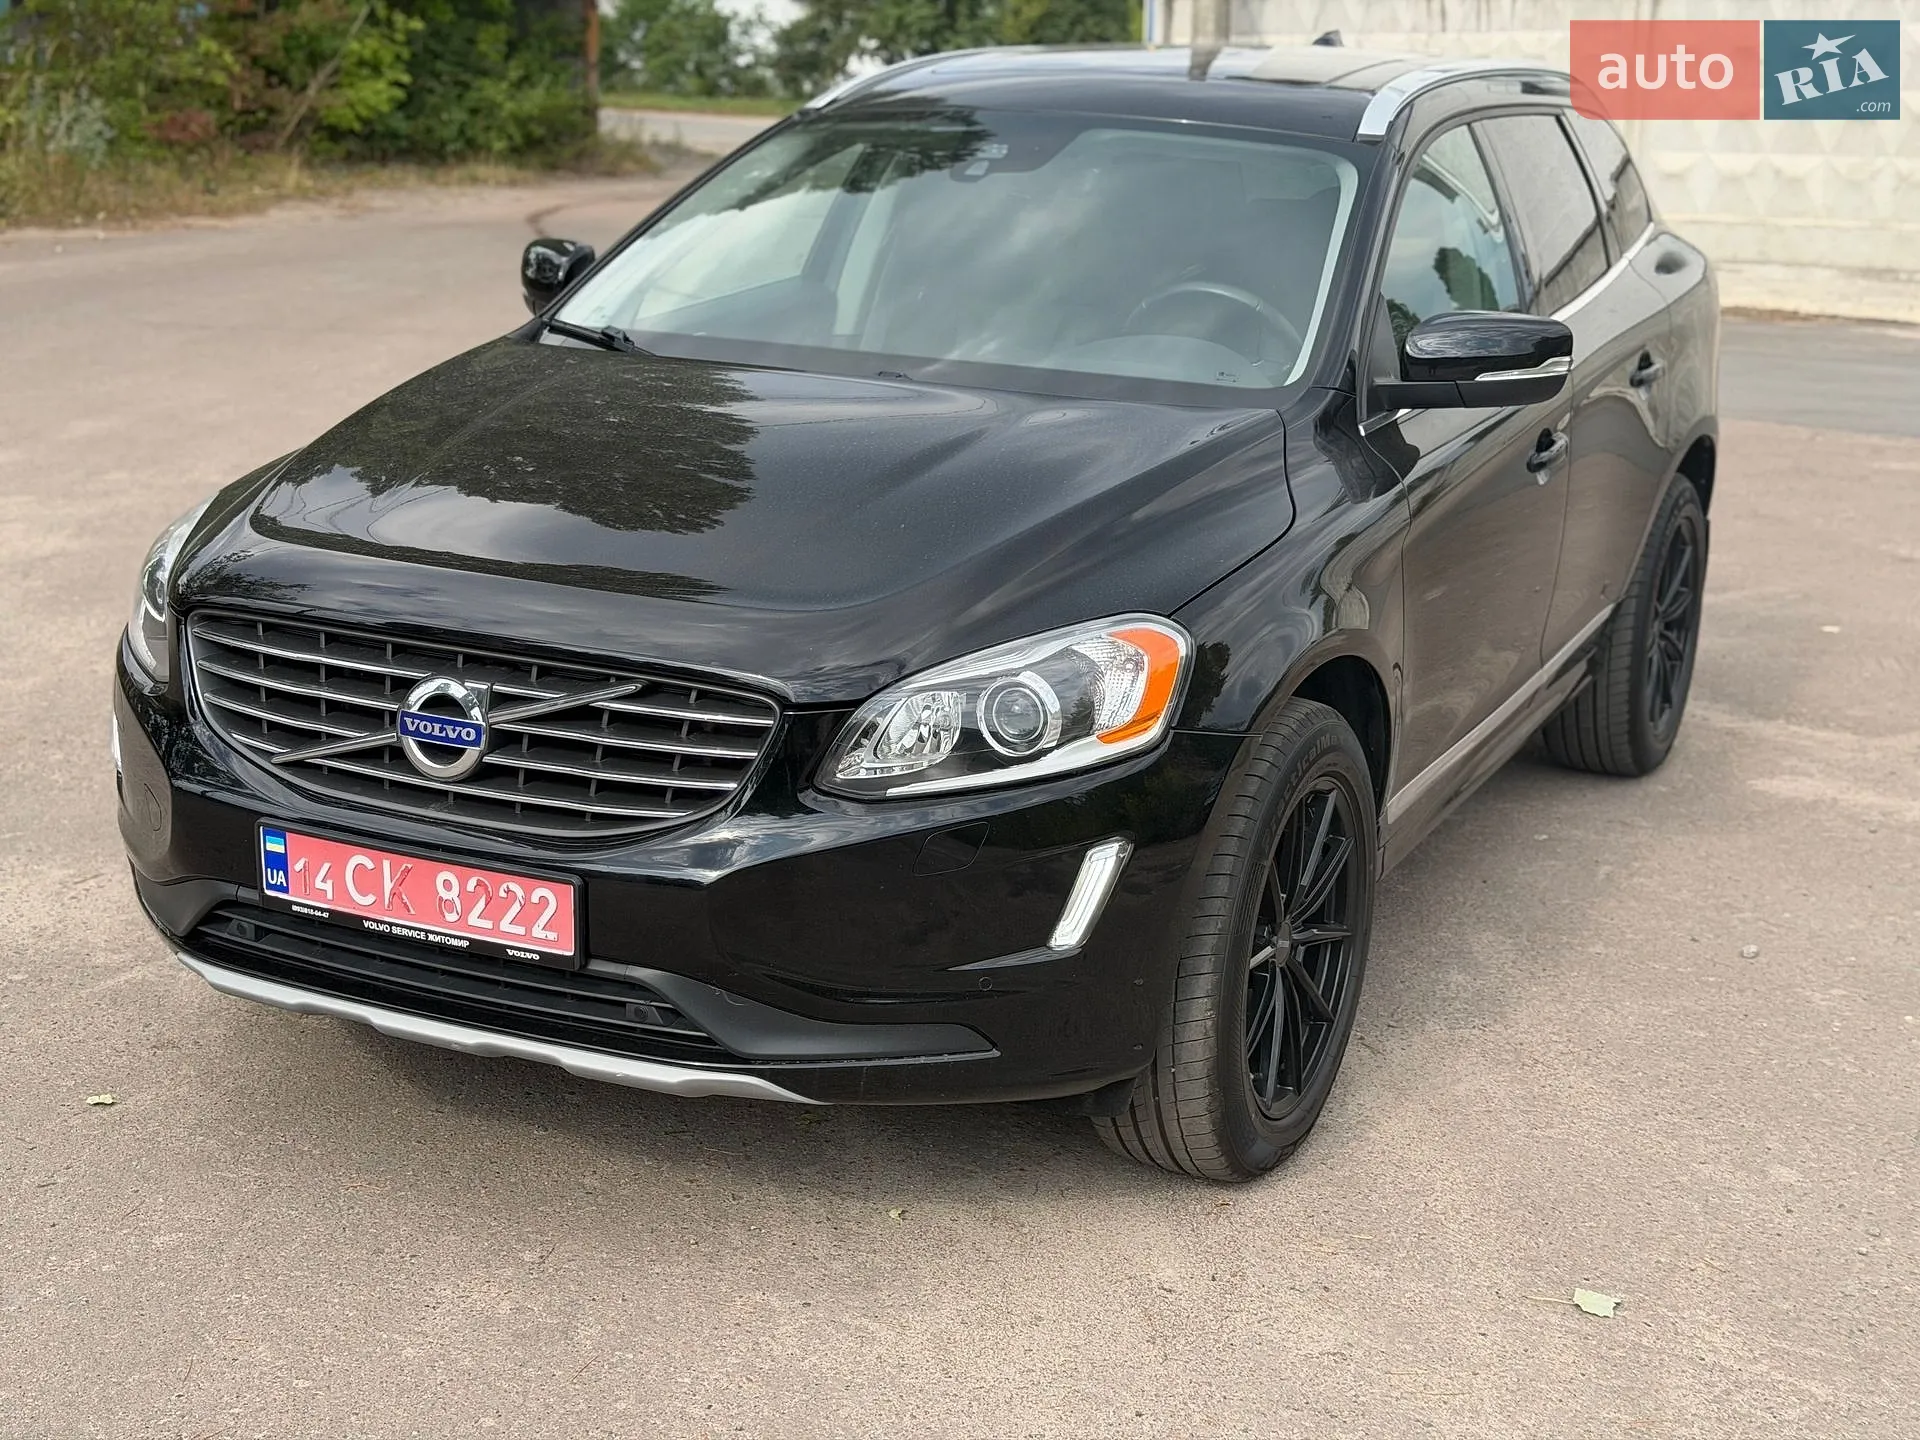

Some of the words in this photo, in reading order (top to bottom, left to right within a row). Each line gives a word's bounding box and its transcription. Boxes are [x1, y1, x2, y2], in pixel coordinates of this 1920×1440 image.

[403, 717, 477, 741] VOLVO
[267, 867, 288, 888] UA
[293, 856, 335, 901] 14
[344, 854, 417, 916] CK
[435, 870, 560, 942] 8222
[362, 919, 391, 933] VOLVO
[391, 926, 427, 941] SERVICE
[427, 933, 470, 949] ЖИТОМИР
[506, 948, 541, 961] VOLVO
